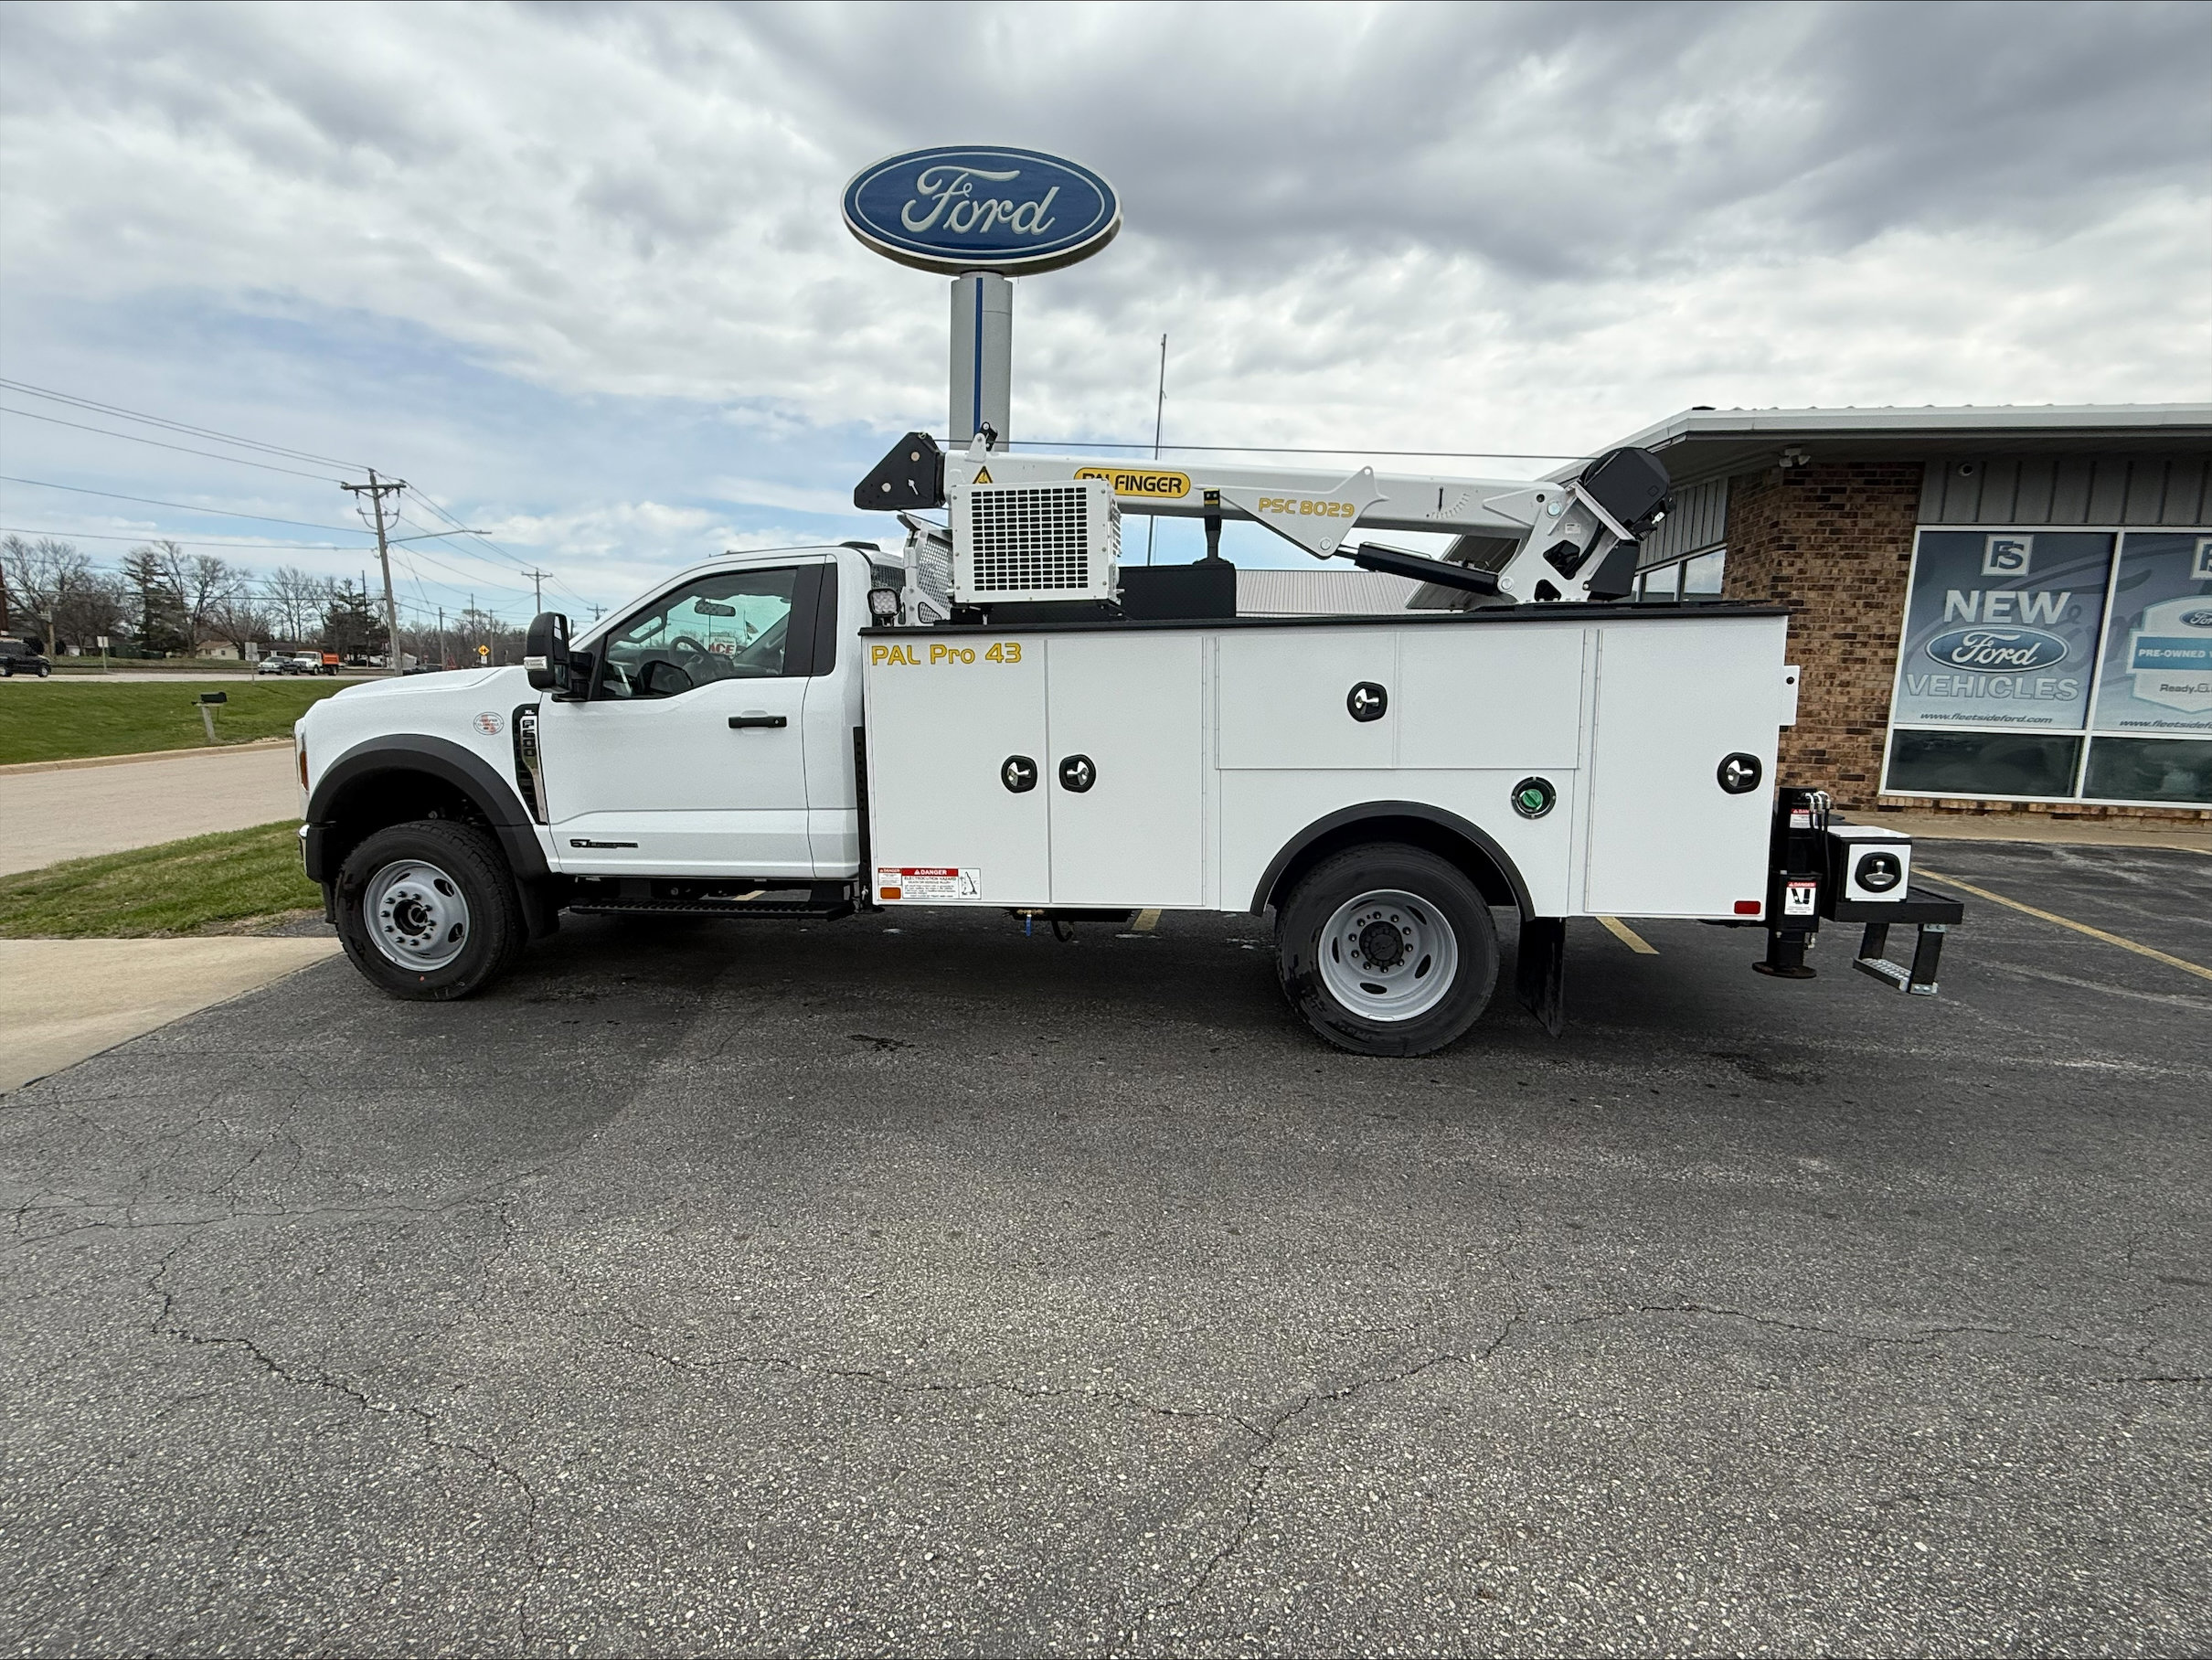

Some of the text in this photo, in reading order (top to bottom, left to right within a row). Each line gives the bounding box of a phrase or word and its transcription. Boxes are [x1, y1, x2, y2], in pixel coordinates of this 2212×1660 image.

[901, 165, 1060, 235] Ford
[1259, 497, 1355, 517] PSC 8029
[1943, 590, 2071, 624] NEW
[871, 643, 1022, 665] PAL Pro 43
[1951, 632, 2041, 665] Ford
[2139, 649, 2206, 658] PRE-OWNED
[1906, 674, 2079, 701] VEHICLES
[1920, 713, 2053, 723] www.fleetsideford.com
